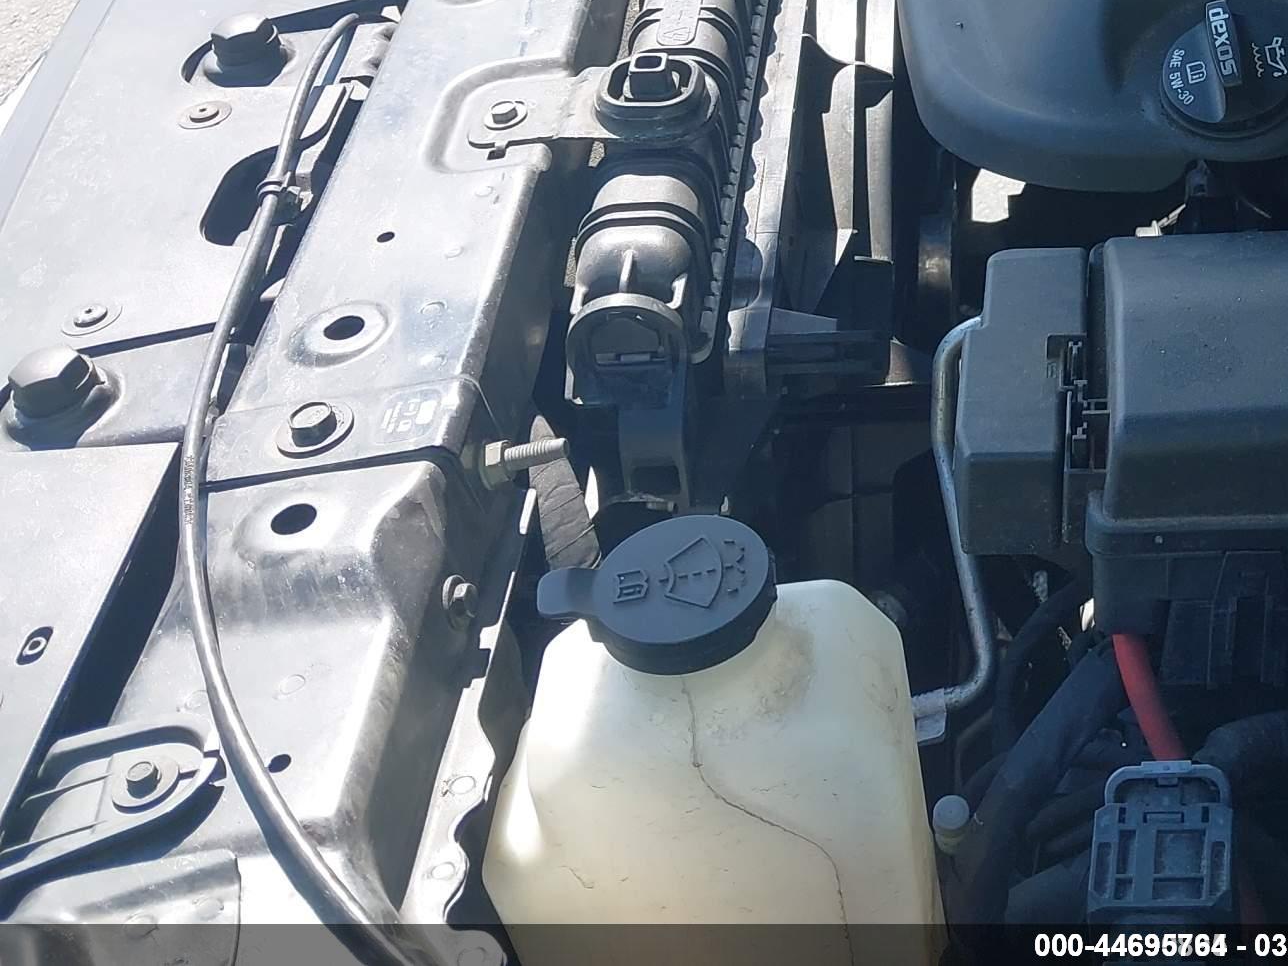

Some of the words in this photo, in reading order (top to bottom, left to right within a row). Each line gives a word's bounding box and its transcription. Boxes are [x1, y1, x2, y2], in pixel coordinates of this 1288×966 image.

[1169, 48, 1186, 69] SAE
[1207, 6, 1240, 77] dexos
[1168, 71, 1195, 106] 5W-30
